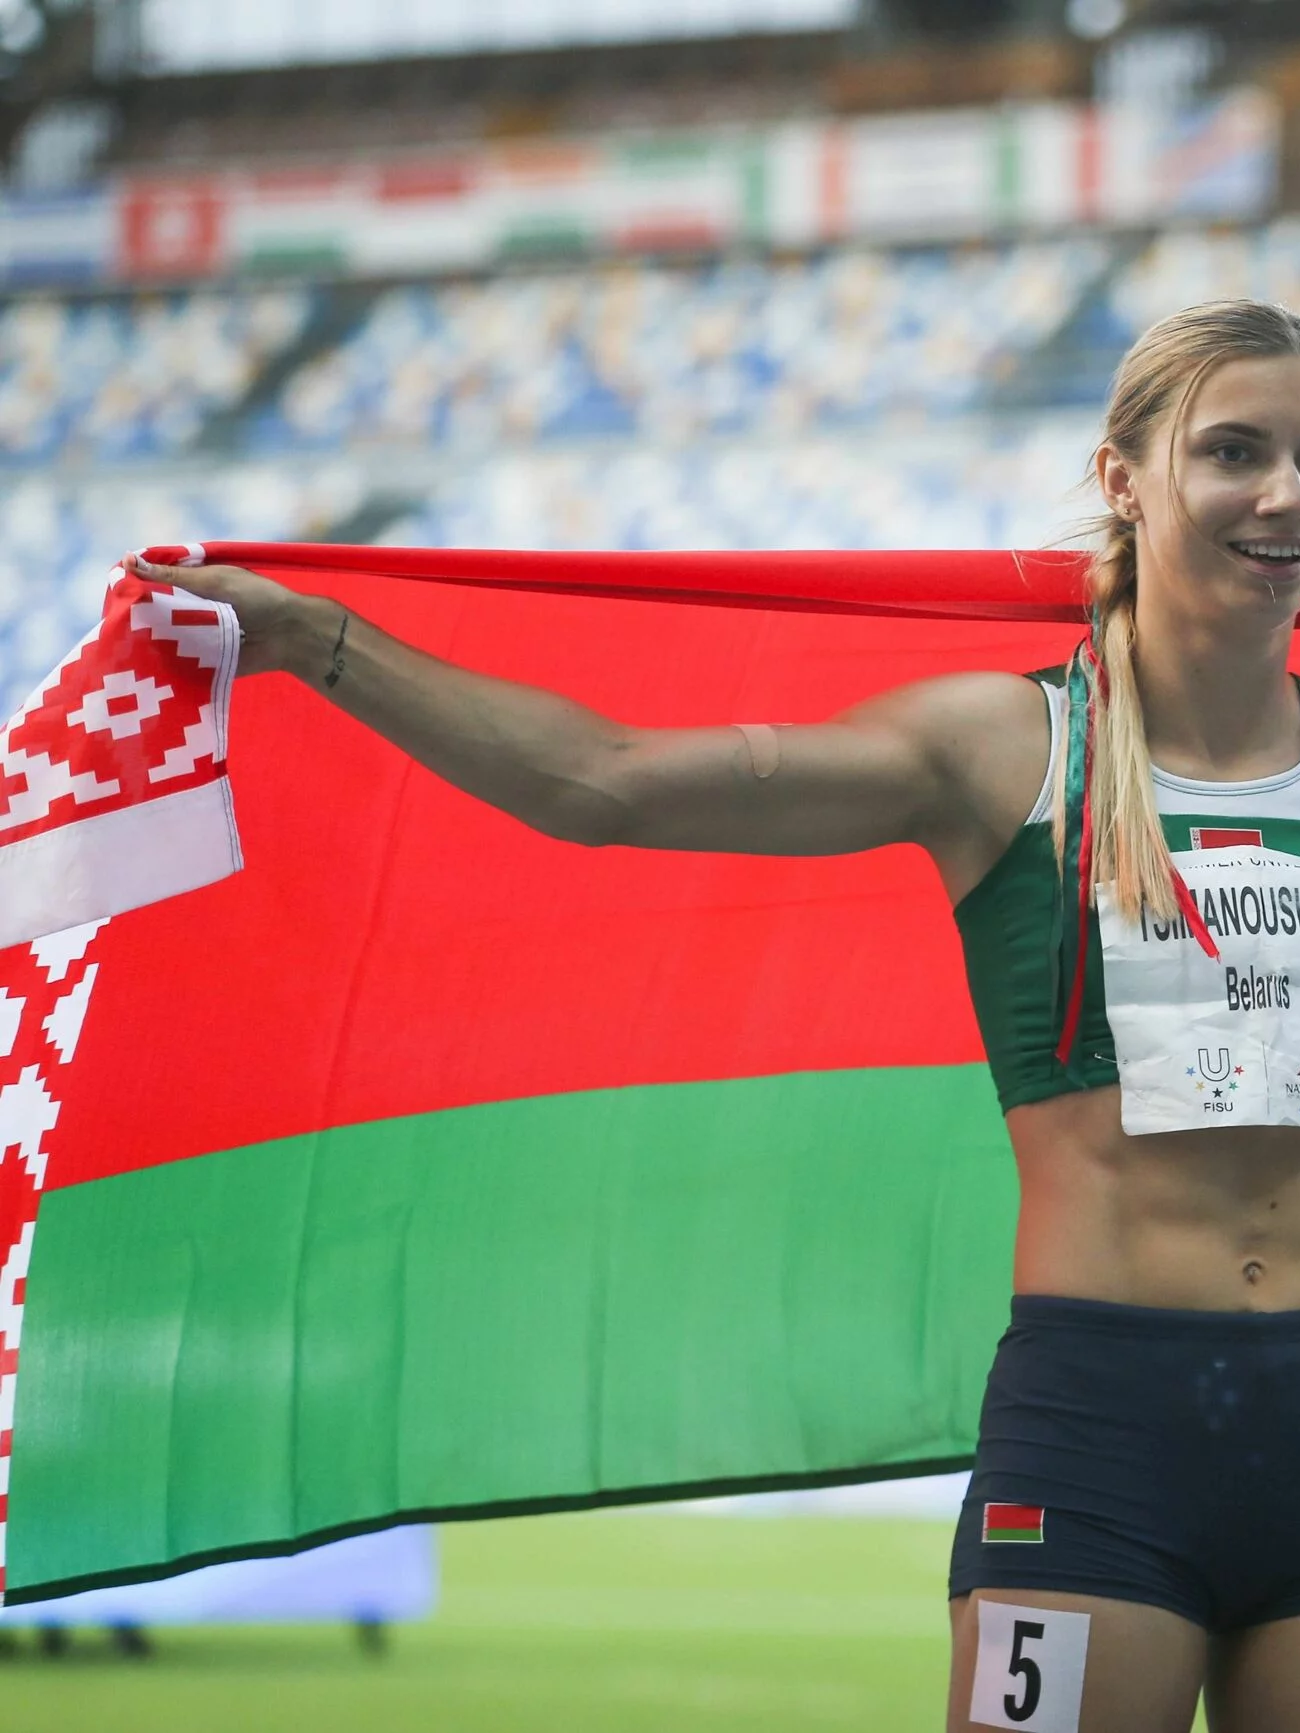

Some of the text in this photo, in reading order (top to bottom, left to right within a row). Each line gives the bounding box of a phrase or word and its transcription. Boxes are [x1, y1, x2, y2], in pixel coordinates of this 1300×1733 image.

[1226, 965, 1290, 1011] Belarus
[1198, 1048, 1231, 1082] U
[1203, 1102, 1234, 1113] FISU
[1003, 1620, 1045, 1722] 5
